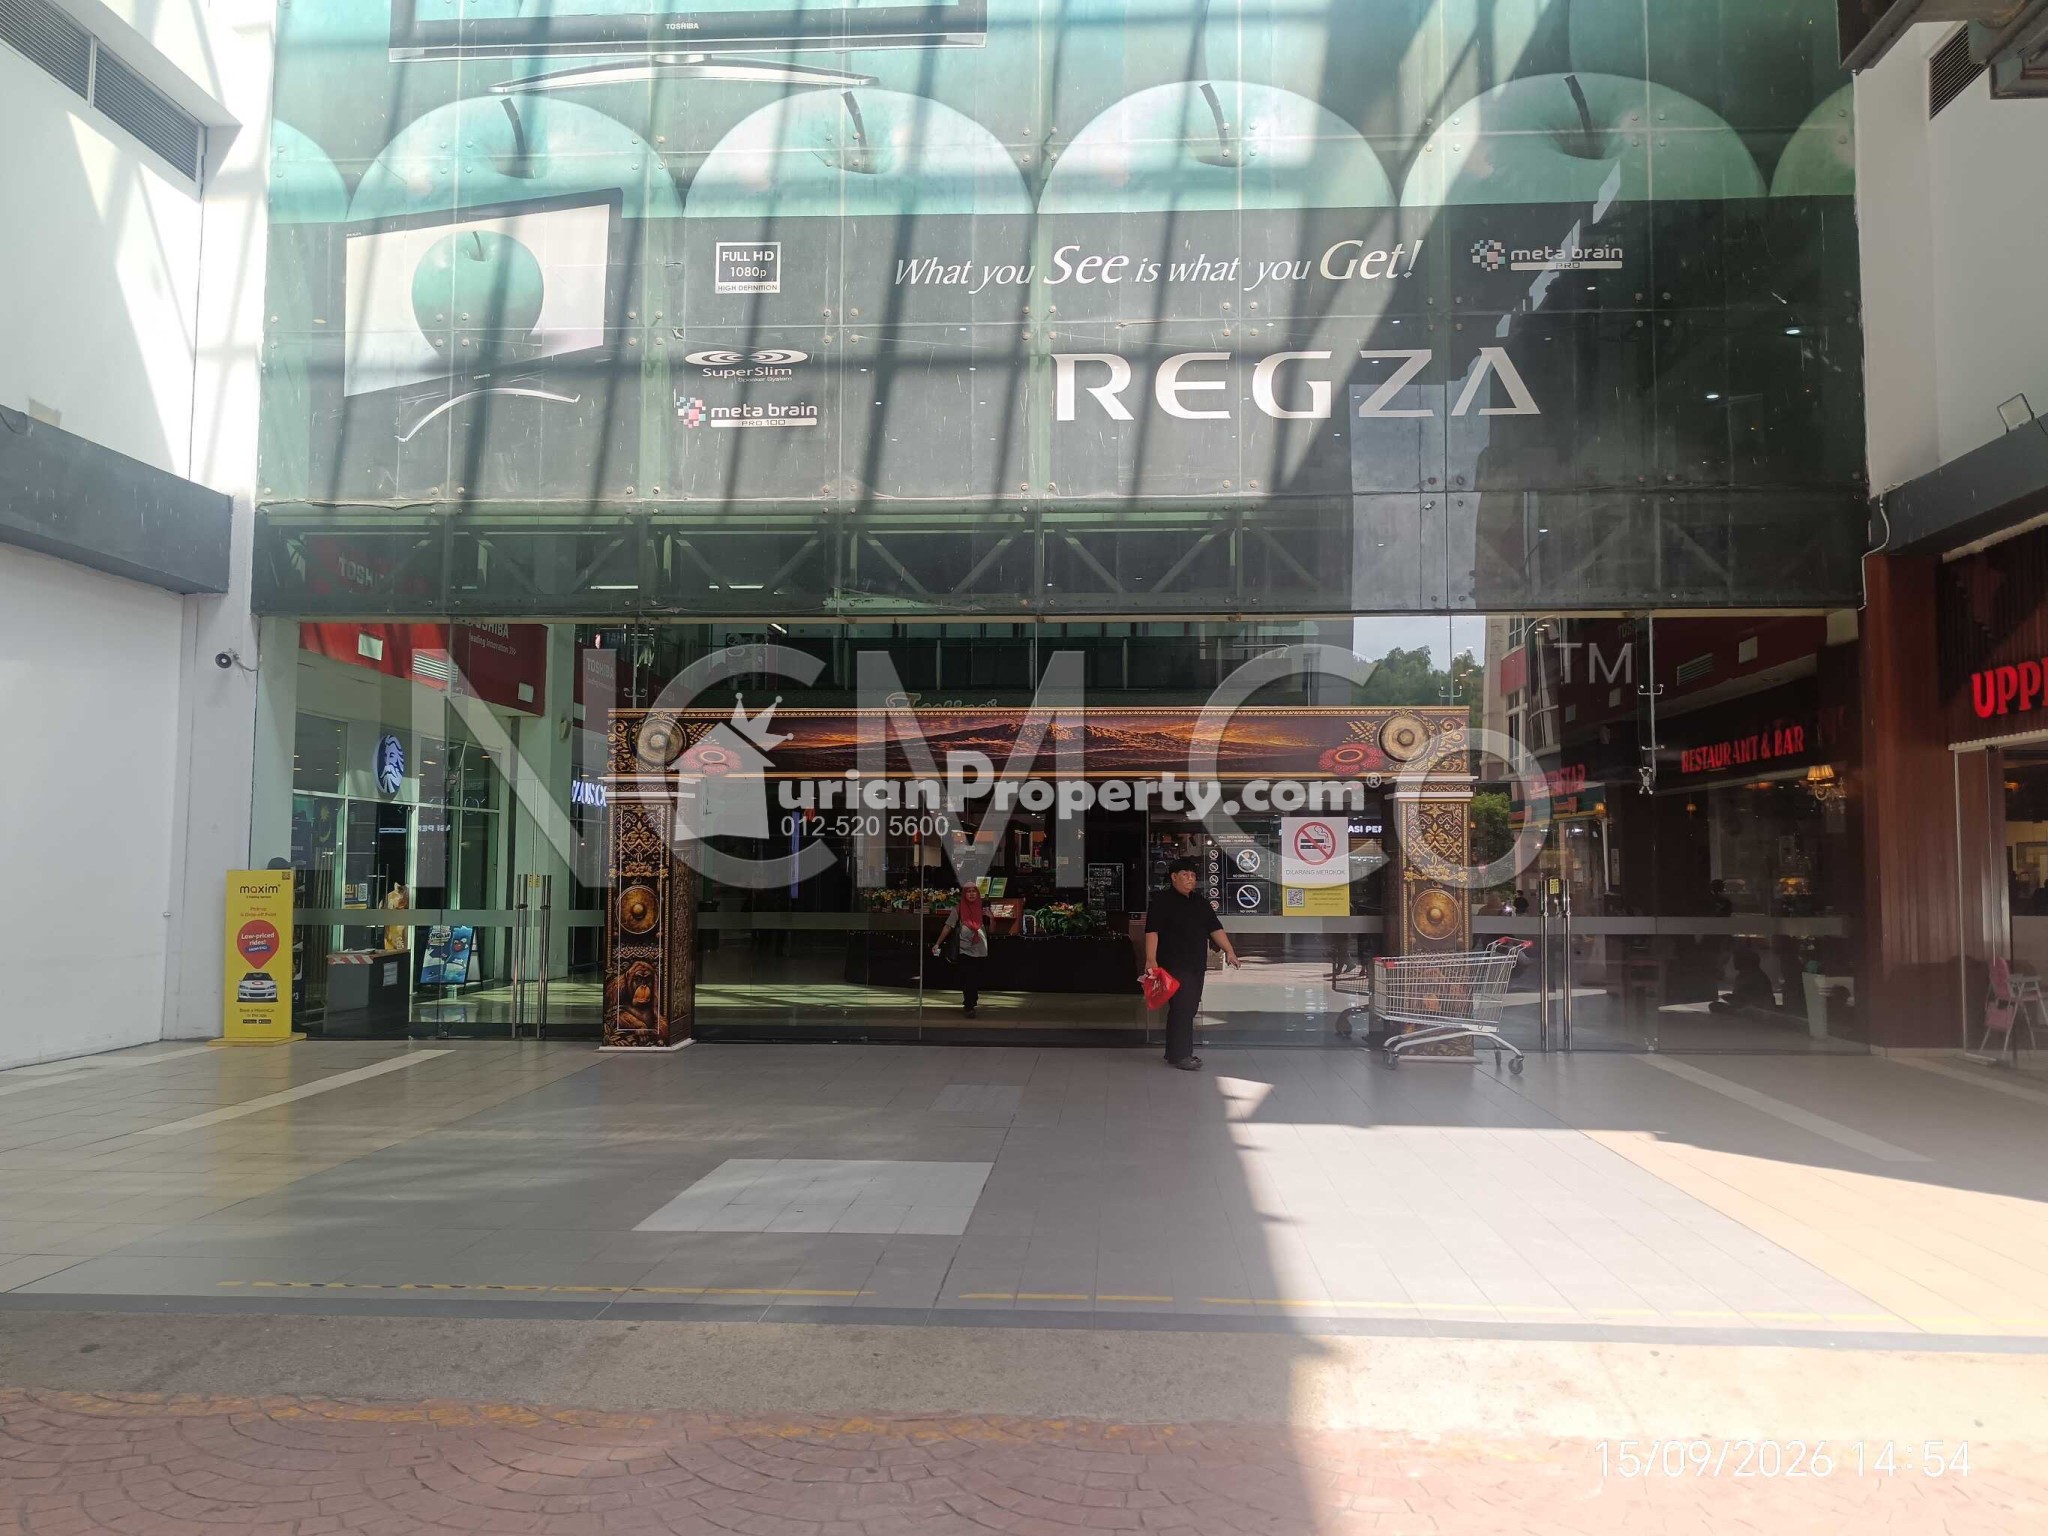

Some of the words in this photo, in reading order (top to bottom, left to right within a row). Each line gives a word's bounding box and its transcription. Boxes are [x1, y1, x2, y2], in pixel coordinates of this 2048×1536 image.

[664, 22, 700, 30] TOSHIBA
[722, 251, 751, 262] FULL
[753, 250, 775, 261] HD
[1510, 245, 1566, 261] meta
[1571, 244, 1623, 260] brain
[730, 266, 767, 279] 1080p
[895, 256, 974, 285] What
[968, 264, 1035, 295] you
[1043, 245, 1130, 285] See
[1134, 257, 1161, 283] is
[1168, 253, 1241, 282] what
[1243, 260, 1312, 292] you
[1319, 239, 1424, 280] Get!
[738, 284, 778, 292] DEFINITION
[702, 366, 792, 379] SuperSlim
[1055, 346, 1541, 421] REGZA
[711, 403, 763, 418] meta
[768, 401, 818, 416] brain
[1971, 656, 2048, 719] UPP
[1681, 735, 1759, 774] RESTAURANT
[1774, 725, 1805, 757] BAR
[239, 883, 280, 894] maxim
[241, 931, 275, 941] Low-priced
